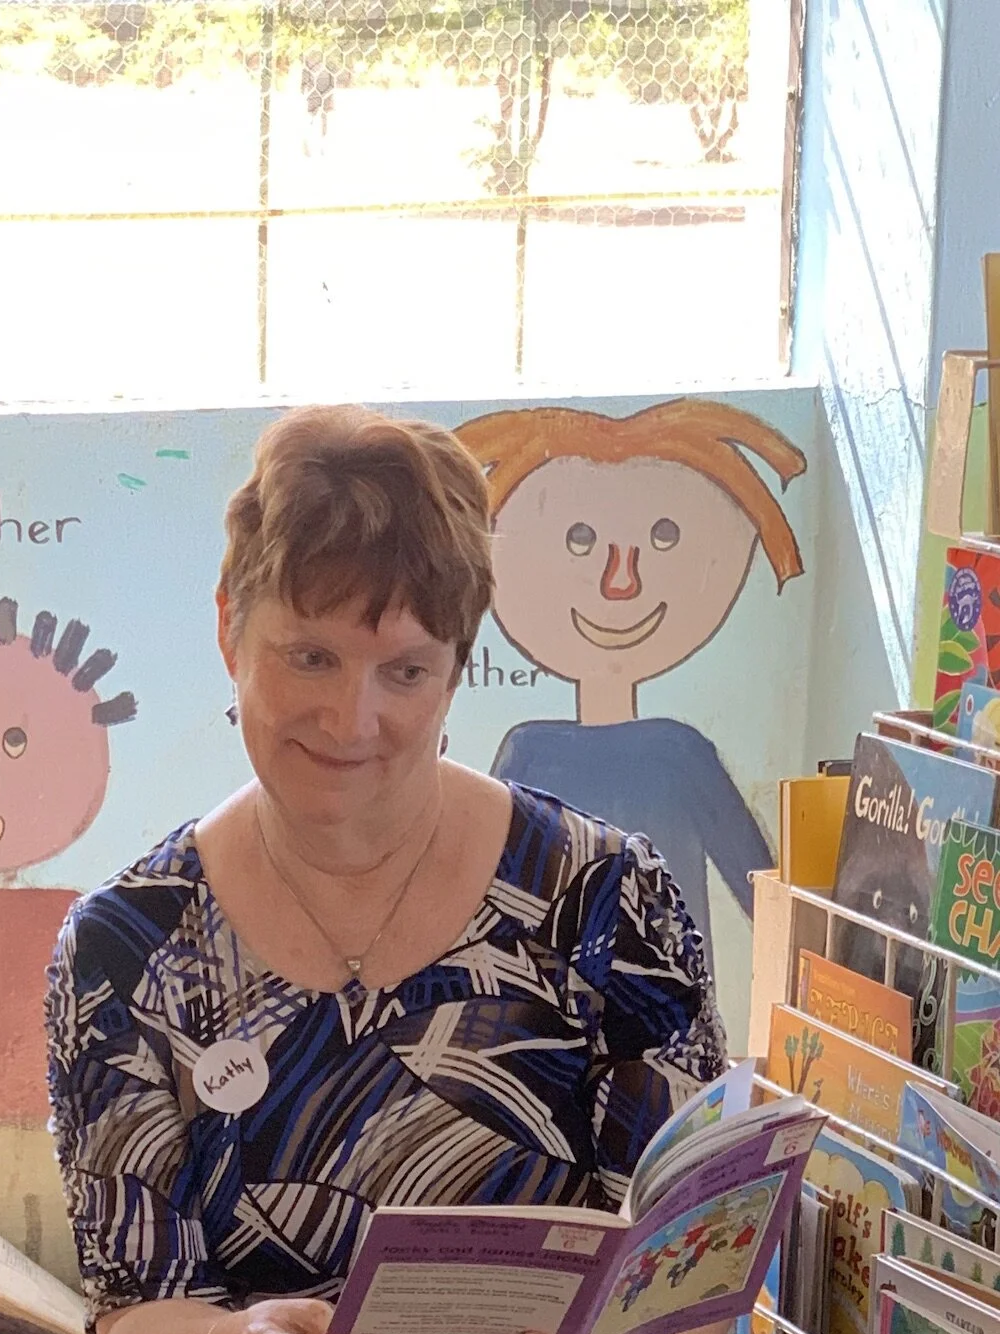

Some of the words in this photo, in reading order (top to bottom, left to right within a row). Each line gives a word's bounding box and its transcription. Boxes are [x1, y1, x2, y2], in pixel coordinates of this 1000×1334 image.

[464, 646, 549, 688] ther
[855, 775, 916, 835] Gorilla!
[203, 1057, 255, 1095] Kathy
